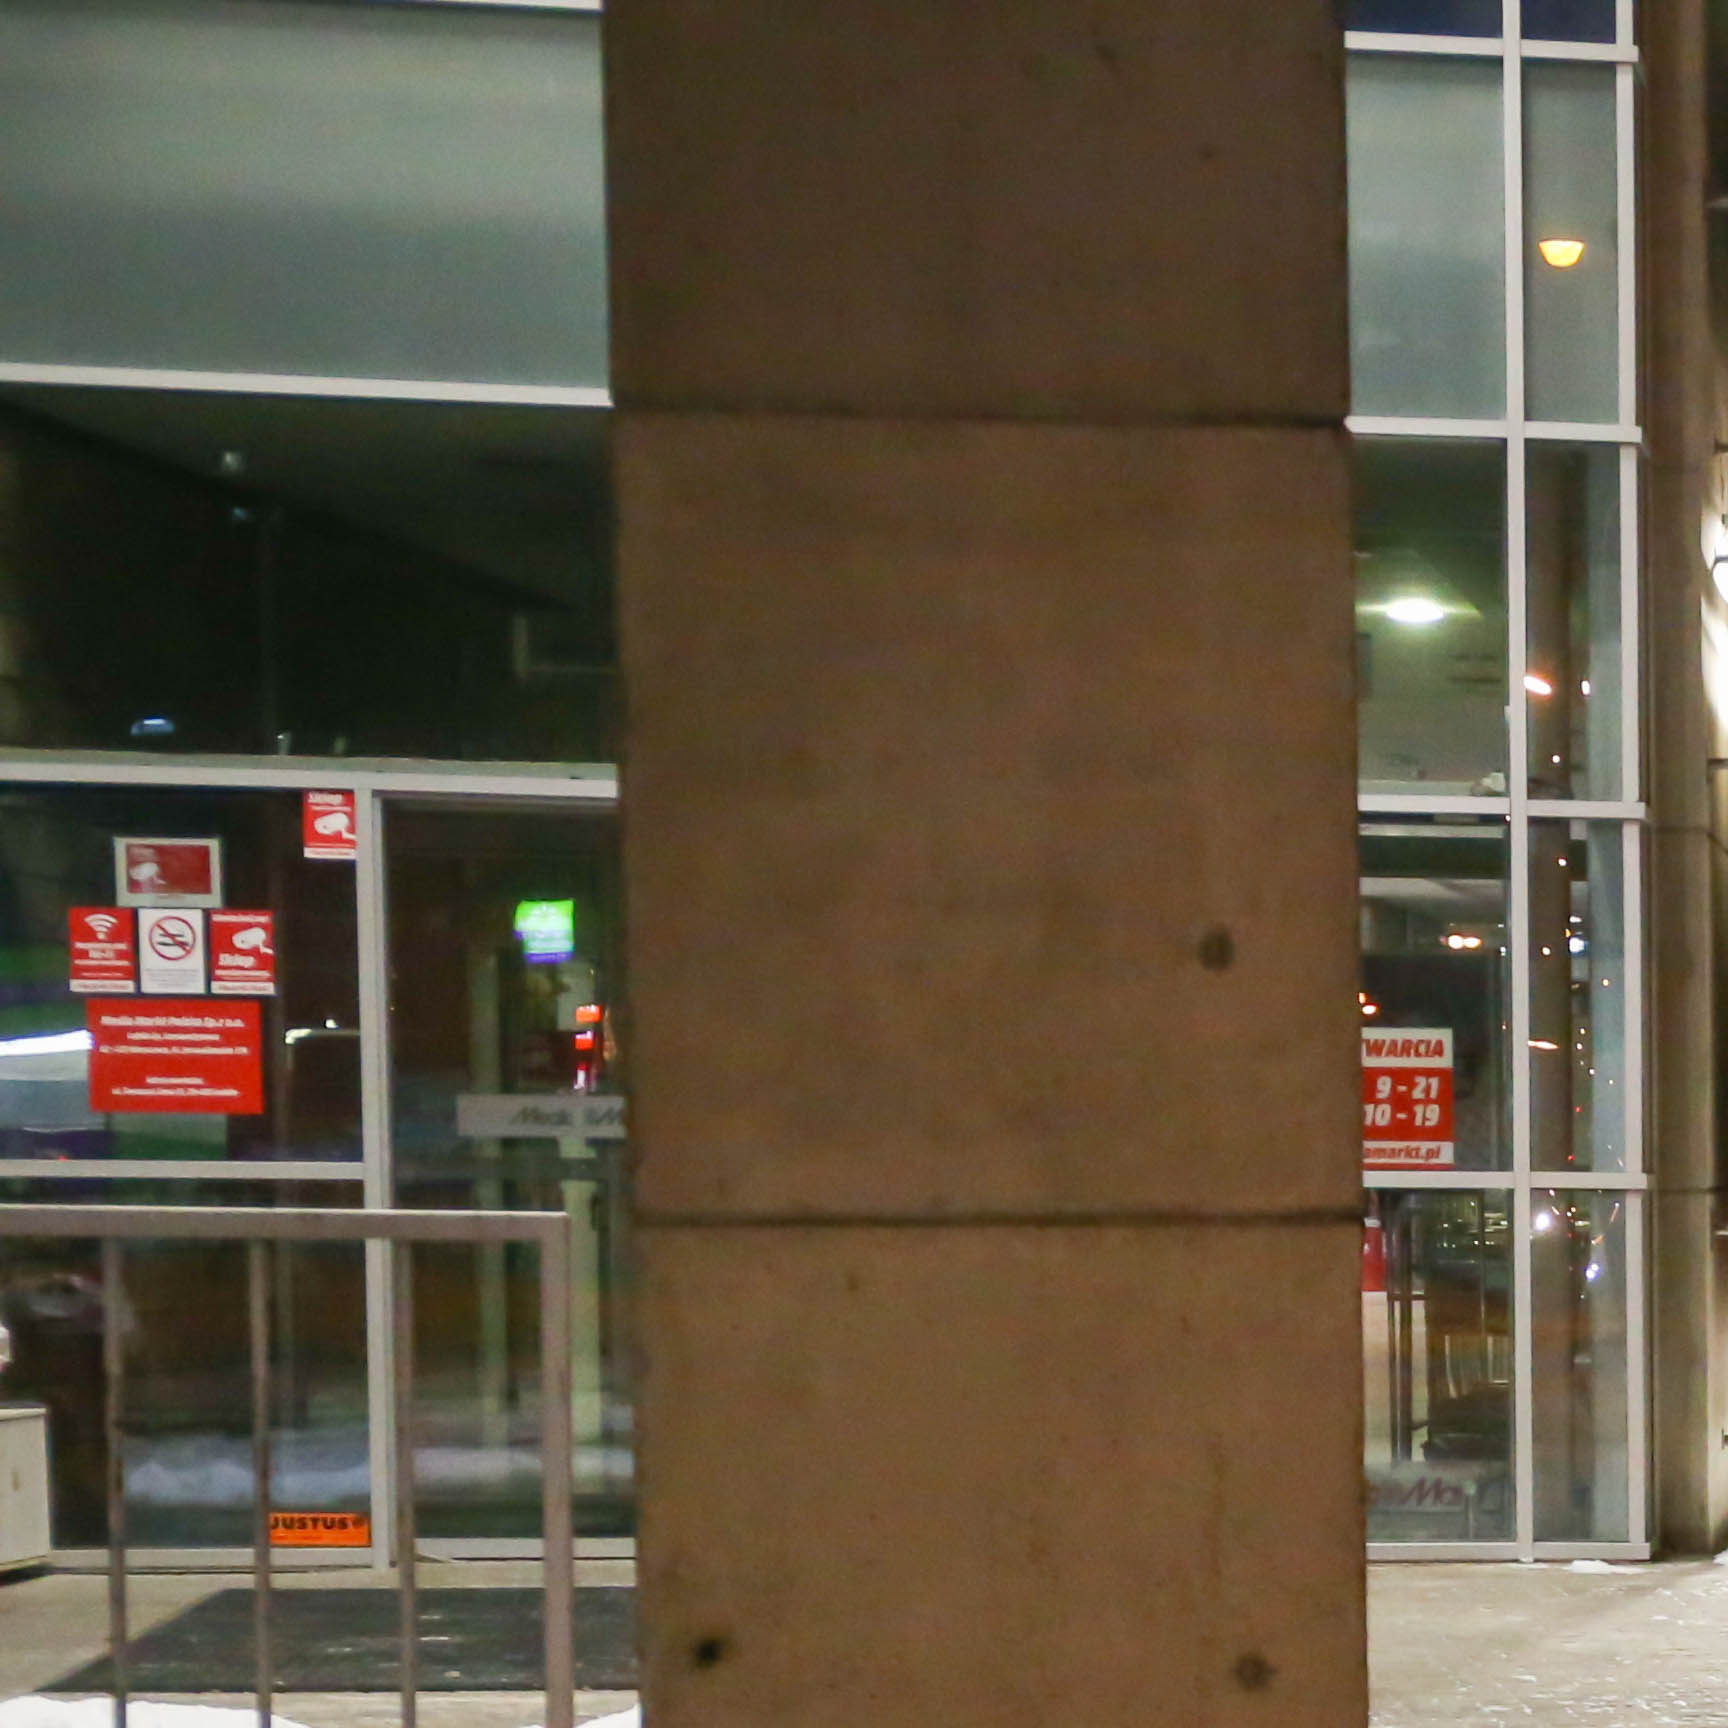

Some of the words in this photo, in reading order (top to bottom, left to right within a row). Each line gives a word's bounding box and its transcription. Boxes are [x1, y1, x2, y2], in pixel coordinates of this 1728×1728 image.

[1362, 1039, 1445, 1058] WARCIA
[1376, 1076, 1392, 1099] 9
[1411, 1076, 1439, 1100] 21
[1363, 1104, 1392, 1127] 10
[1413, 1104, 1440, 1127] 19
[271, 1516, 349, 1531] JUSTUS
